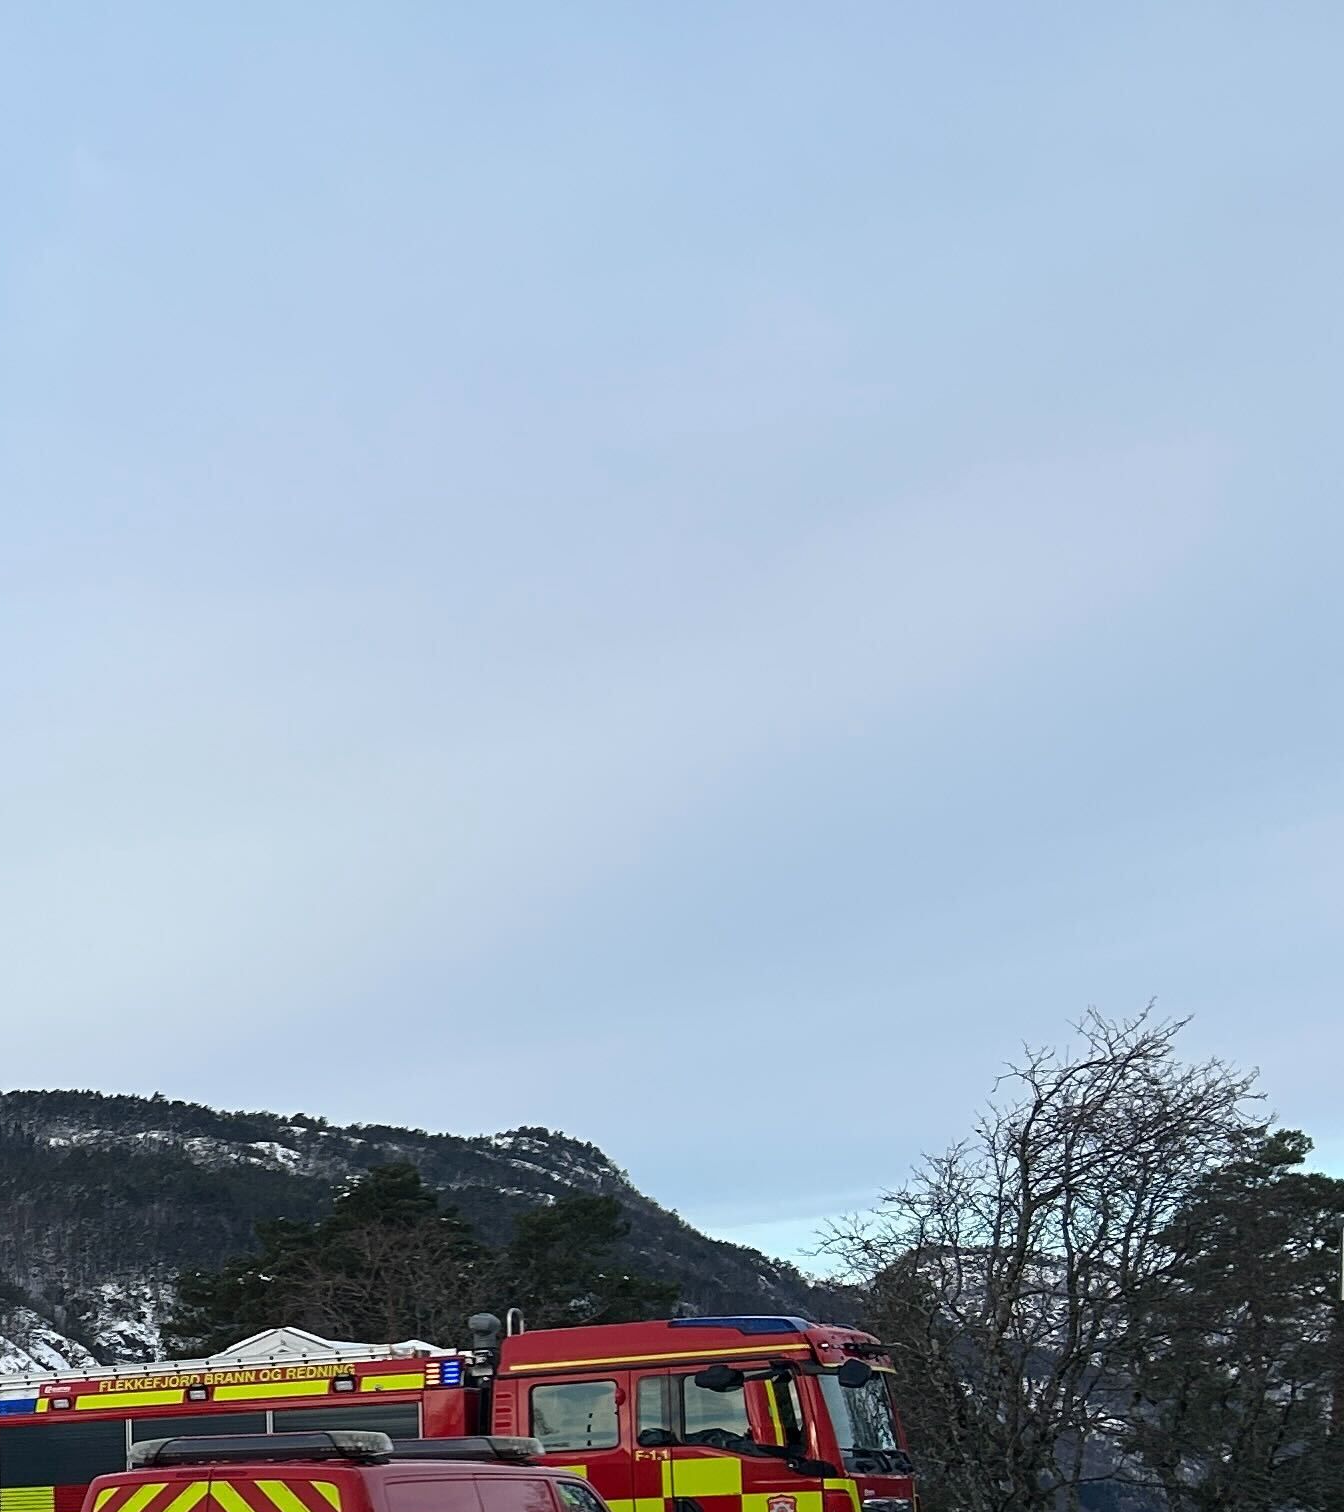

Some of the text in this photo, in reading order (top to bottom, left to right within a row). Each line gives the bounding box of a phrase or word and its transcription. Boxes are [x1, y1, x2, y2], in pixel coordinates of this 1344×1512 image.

[98, 1363, 356, 1393] FLEKKEFJORD BRANN OG REDNING
[634, 1448, 669, 1462] F-1.1
